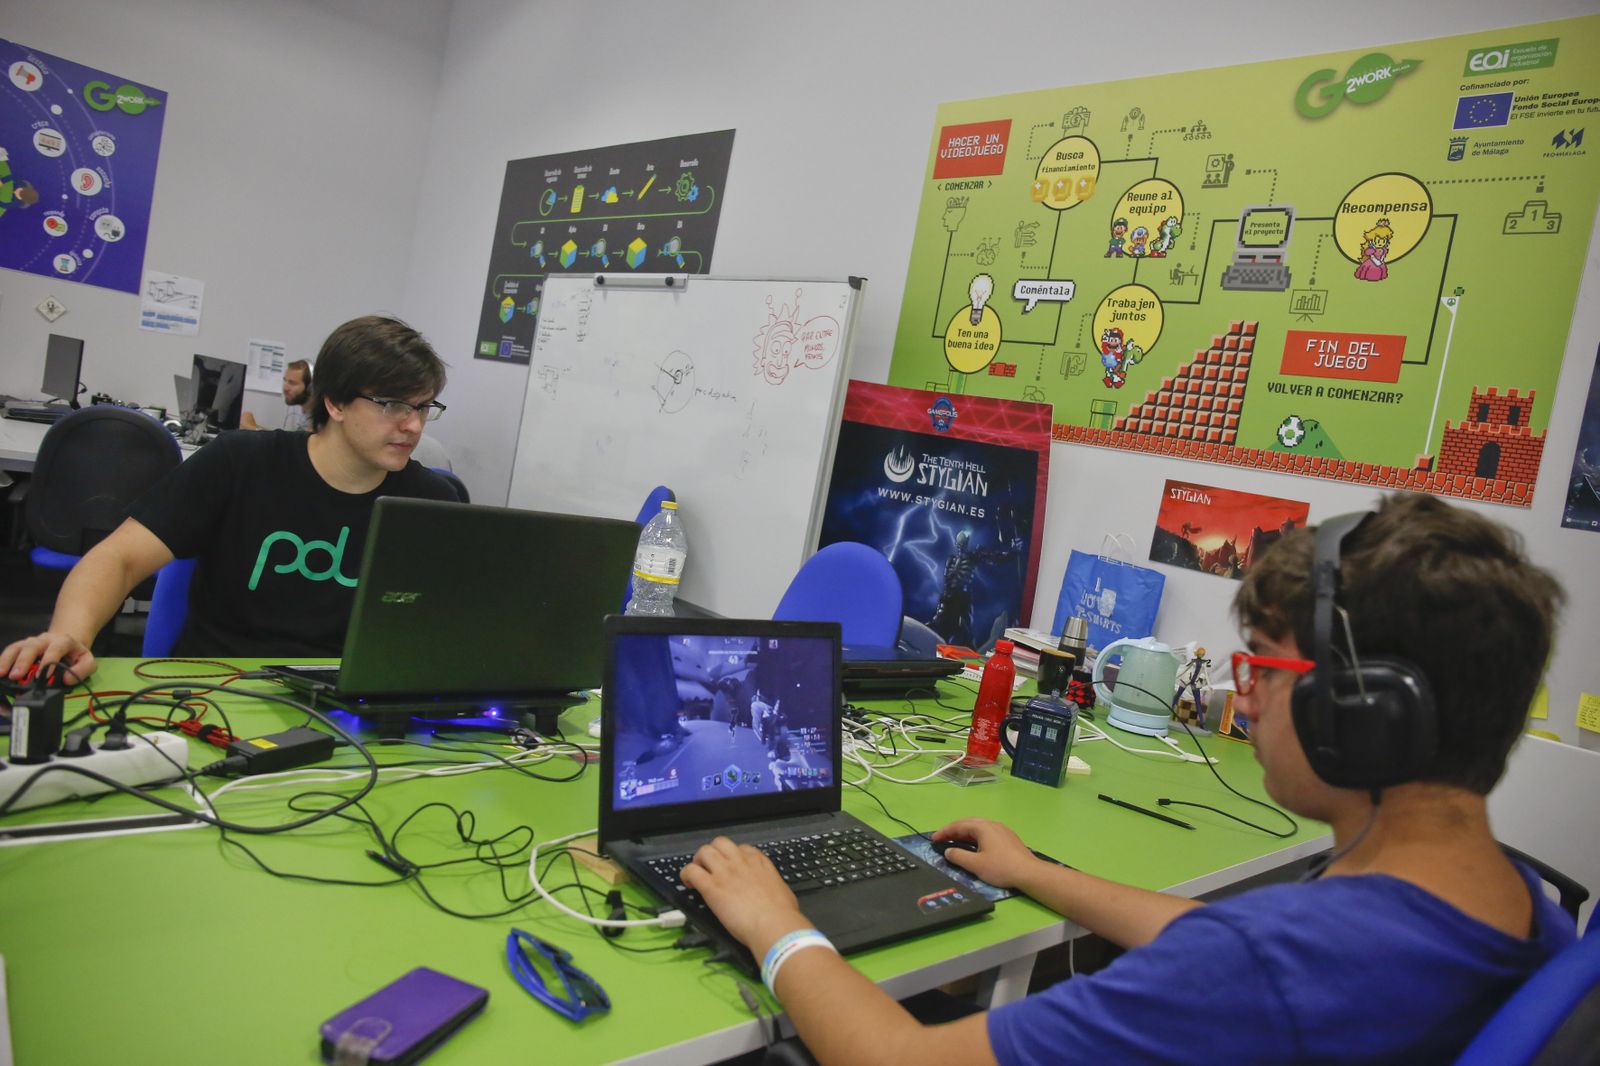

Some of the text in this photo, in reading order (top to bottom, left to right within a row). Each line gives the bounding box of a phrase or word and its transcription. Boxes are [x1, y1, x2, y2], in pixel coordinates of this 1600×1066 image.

[1346, 66, 1392, 94] 2WORK
[1460, 79, 1530, 91] Cofinanciado por:
[1541, 91, 1580, 101] Europea
[1512, 103, 1538, 111] Fondo
[1541, 99, 1569, 108] Social
[1519, 111, 1535, 119] FSE
[1537, 110, 1564, 118] invierte
[948, 133, 1000, 147] HACER UN
[1473, 139, 1525, 148] Ayuntamiento
[941, 144, 1004, 158] VIDEOJUEGO
[1055, 151, 1084, 161] Busca
[1482, 147, 1509, 156] Málaga
[1041, 164, 1096, 173] financiamiento
[944, 181, 984, 191] COMENZAR
[1127, 190, 1173, 202] Reune al
[1129, 203, 1166, 216] equipo
[1341, 201, 1428, 216] Recompensa
[1250, 221, 1281, 229] Presenta
[1255, 228, 1284, 237] proyecto
[1020, 284, 1070, 296] Coméntala
[1107, 298, 1155, 311] Trabajen
[1109, 310, 1147, 323] juntos
[957, 328, 989, 339] Ten una
[947, 339, 994, 351] buena idea
[1306, 339, 1381, 357] FIN DEL
[1313, 354, 1368, 370] JUEGO
[1267, 381, 1404, 404] VOLVER A COMENZAR?
[922, 453, 986, 474] THE TENTH HELL
[917, 462, 989, 497] STYGIAN
[878, 487, 986, 518] WWW.STYGIAN.ES
[1170, 488, 1212, 505] STYGIAN
